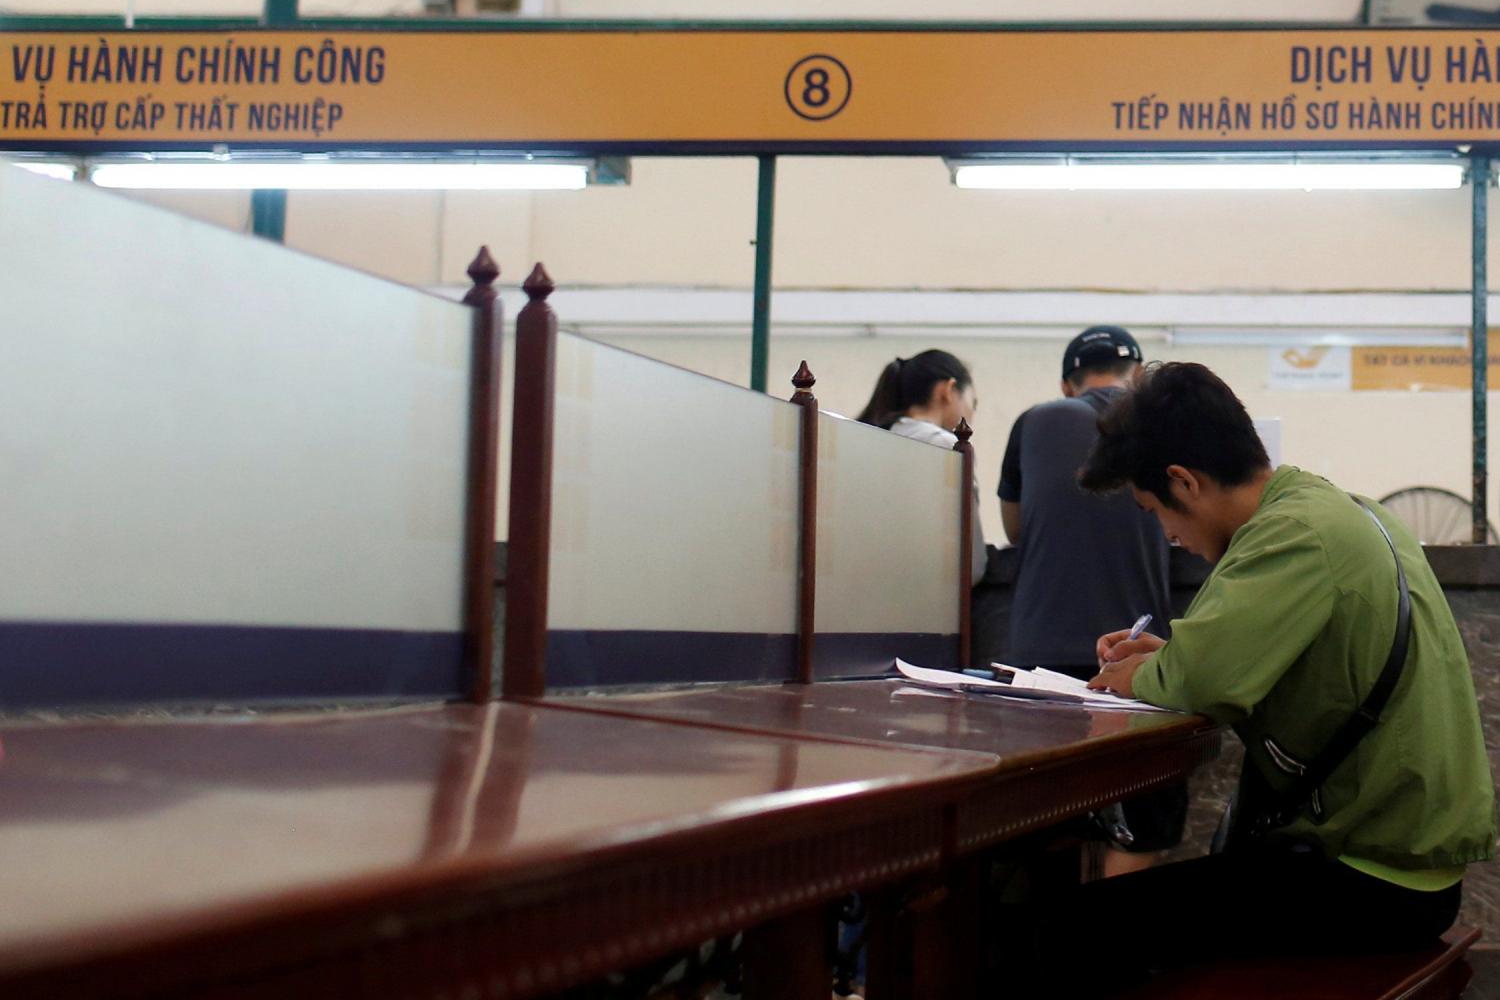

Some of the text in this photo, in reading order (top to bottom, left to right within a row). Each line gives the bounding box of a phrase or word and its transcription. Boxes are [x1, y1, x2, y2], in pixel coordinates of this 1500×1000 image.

[11, 37, 385, 90] VỤ HÀNH CHÍNH CÔNG
[1291, 46, 1372, 90] DỊCH
[1386, 46, 1431, 91] VỤ
[802, 67, 830, 108] 8
[58, 100, 108, 136] TRỢ
[114, 94, 165, 131] CẤP
[174, 94, 240, 131] THẤT
[247, 97, 343, 136] NGHIỆP
[1112, 93, 1169, 130] TIẾP
[1178, 96, 1251, 136] NHẬN
[1305, 101, 1340, 130] SƠ
[1348, 96, 1424, 130] HÀNH
